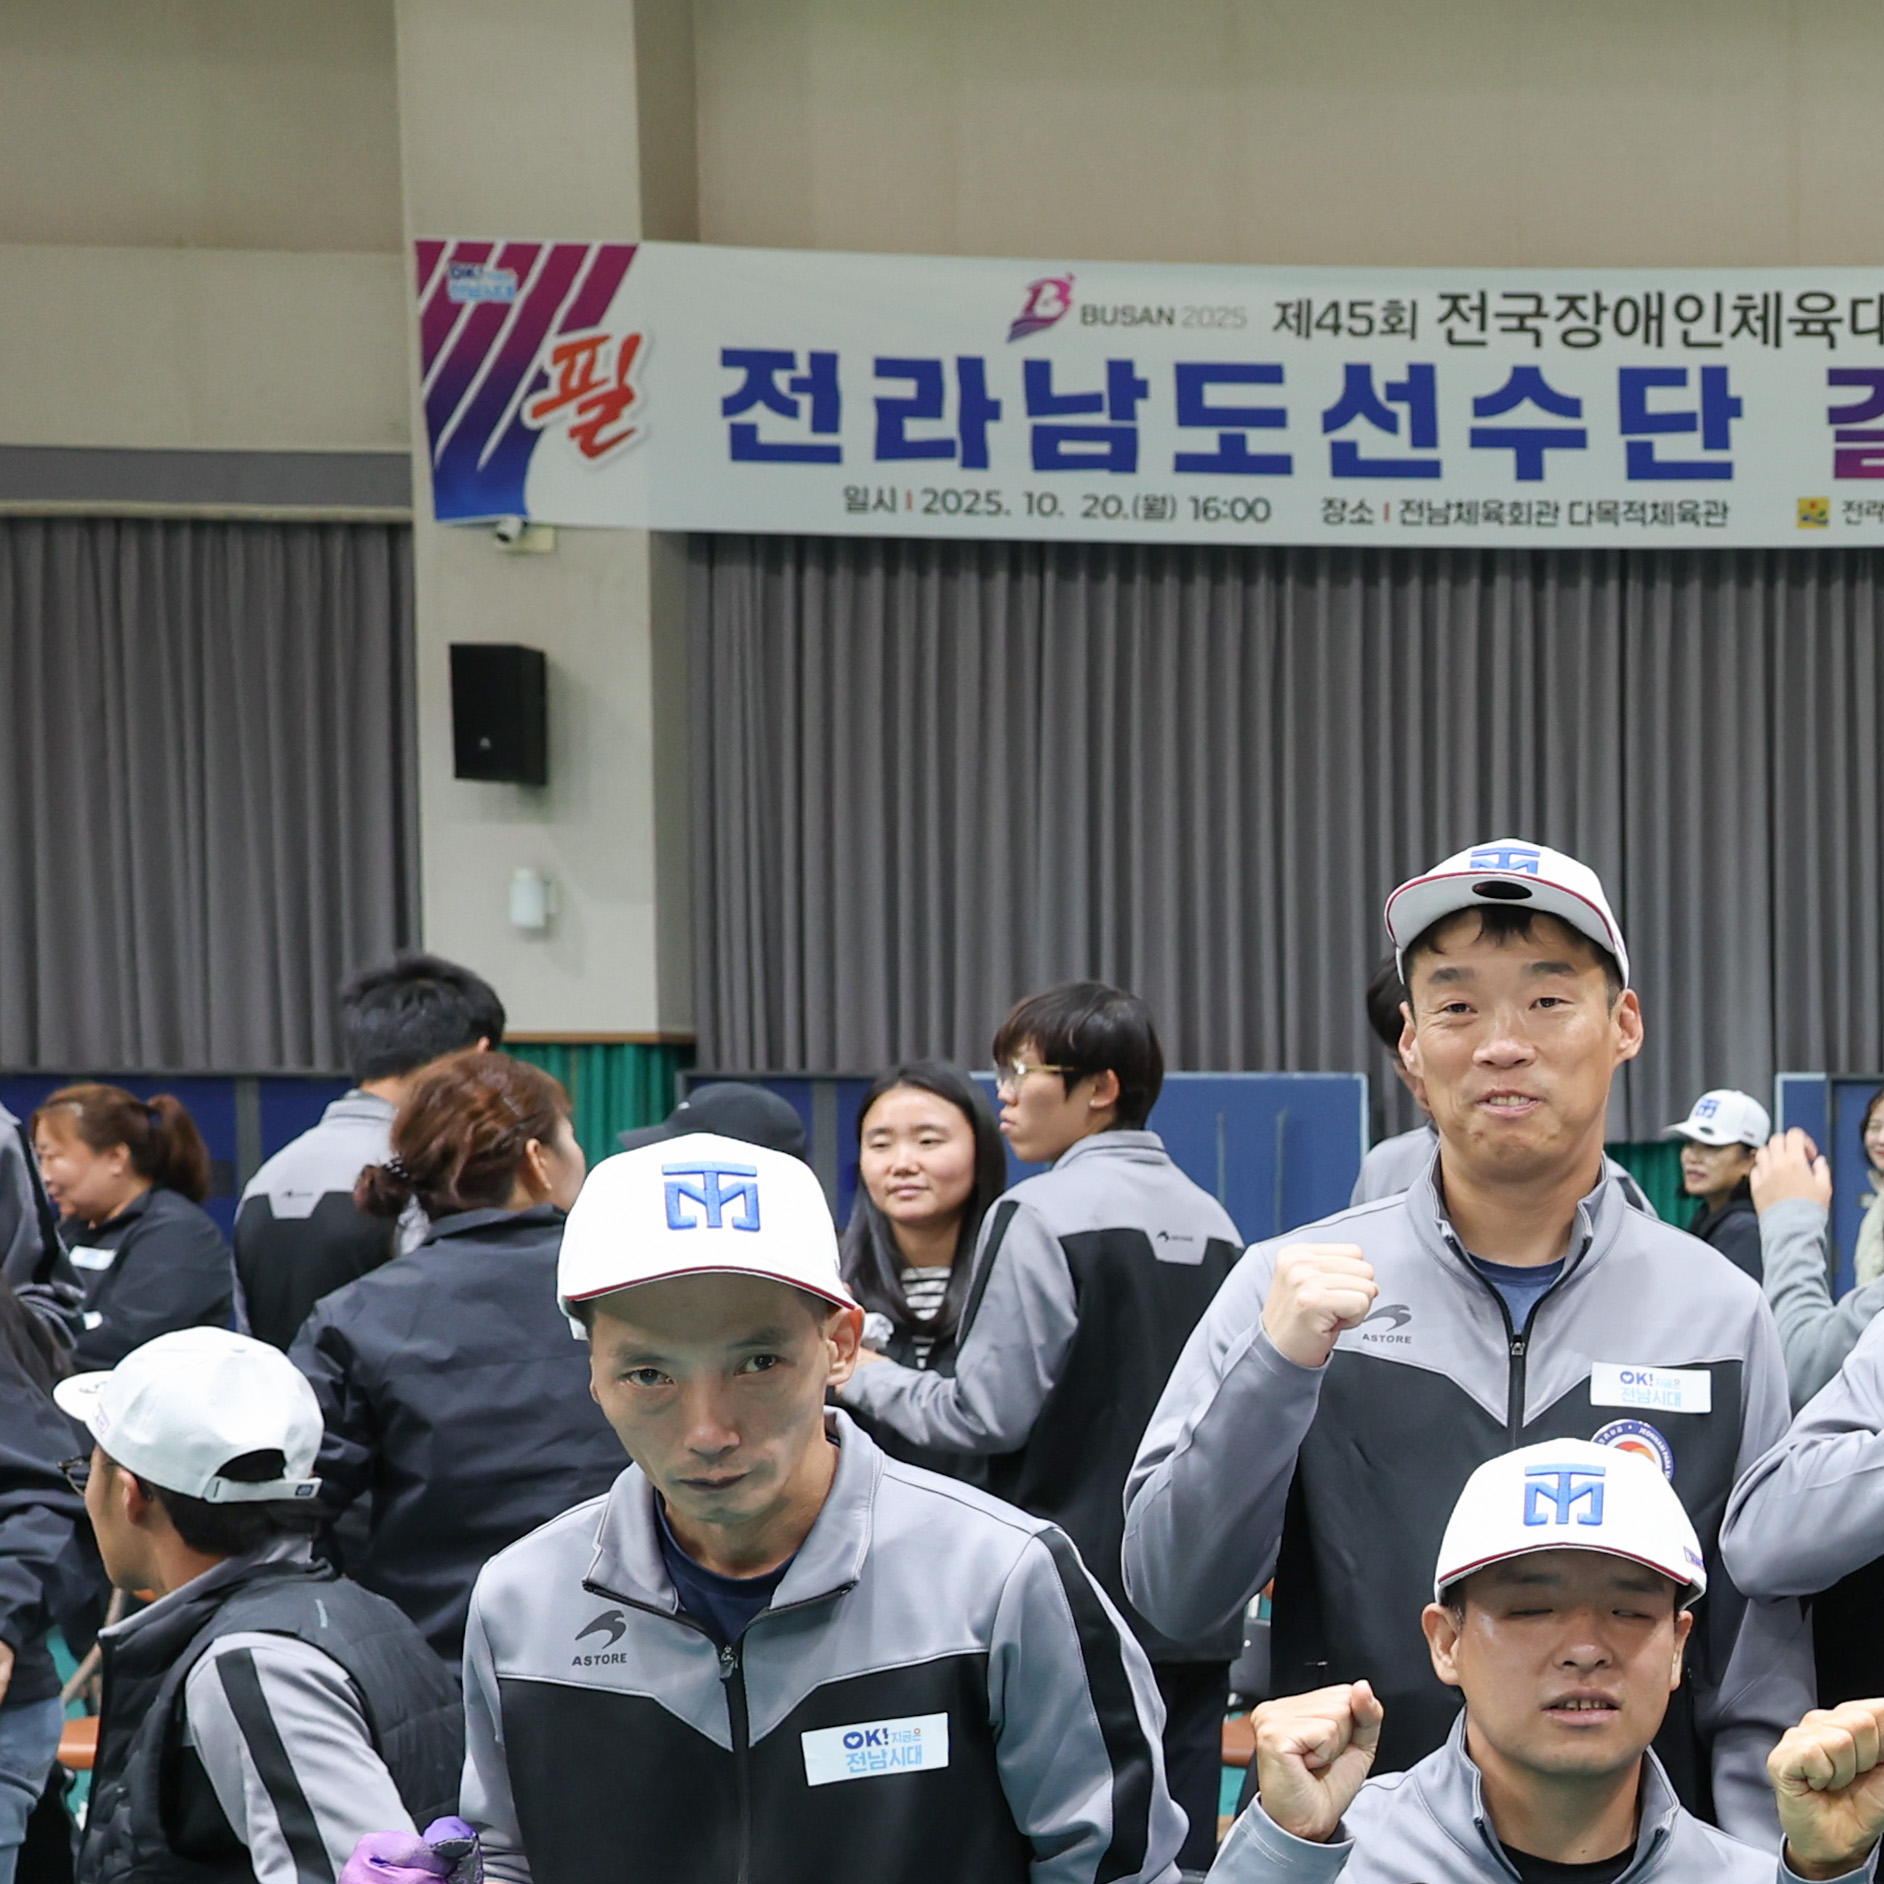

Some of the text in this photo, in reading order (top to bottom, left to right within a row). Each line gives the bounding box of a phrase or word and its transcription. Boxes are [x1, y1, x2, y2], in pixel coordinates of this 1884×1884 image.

[1081, 304, 1247, 329] BUSAN 2025
[1272, 298, 1418, 341] 제45회
[532, 333, 642, 459] 필
[720, 347, 1744, 483] 전라남도선수단
[842, 485, 1272, 523] 일시 2025. 10. 20.(월) 16:00
[1321, 496, 1730, 528] 장소 전남체육회관 다목적체육관
[1362, 1332, 1412, 1344] ASTORE
[1619, 1370, 1653, 1387] OK!
[1620, 1388, 1682, 1409] 전남시대
[571, 1652, 628, 1667] ASTORE
[842, 1727, 923, 1750] OK! 지금은
[845, 1745, 923, 1774] 전남시대
